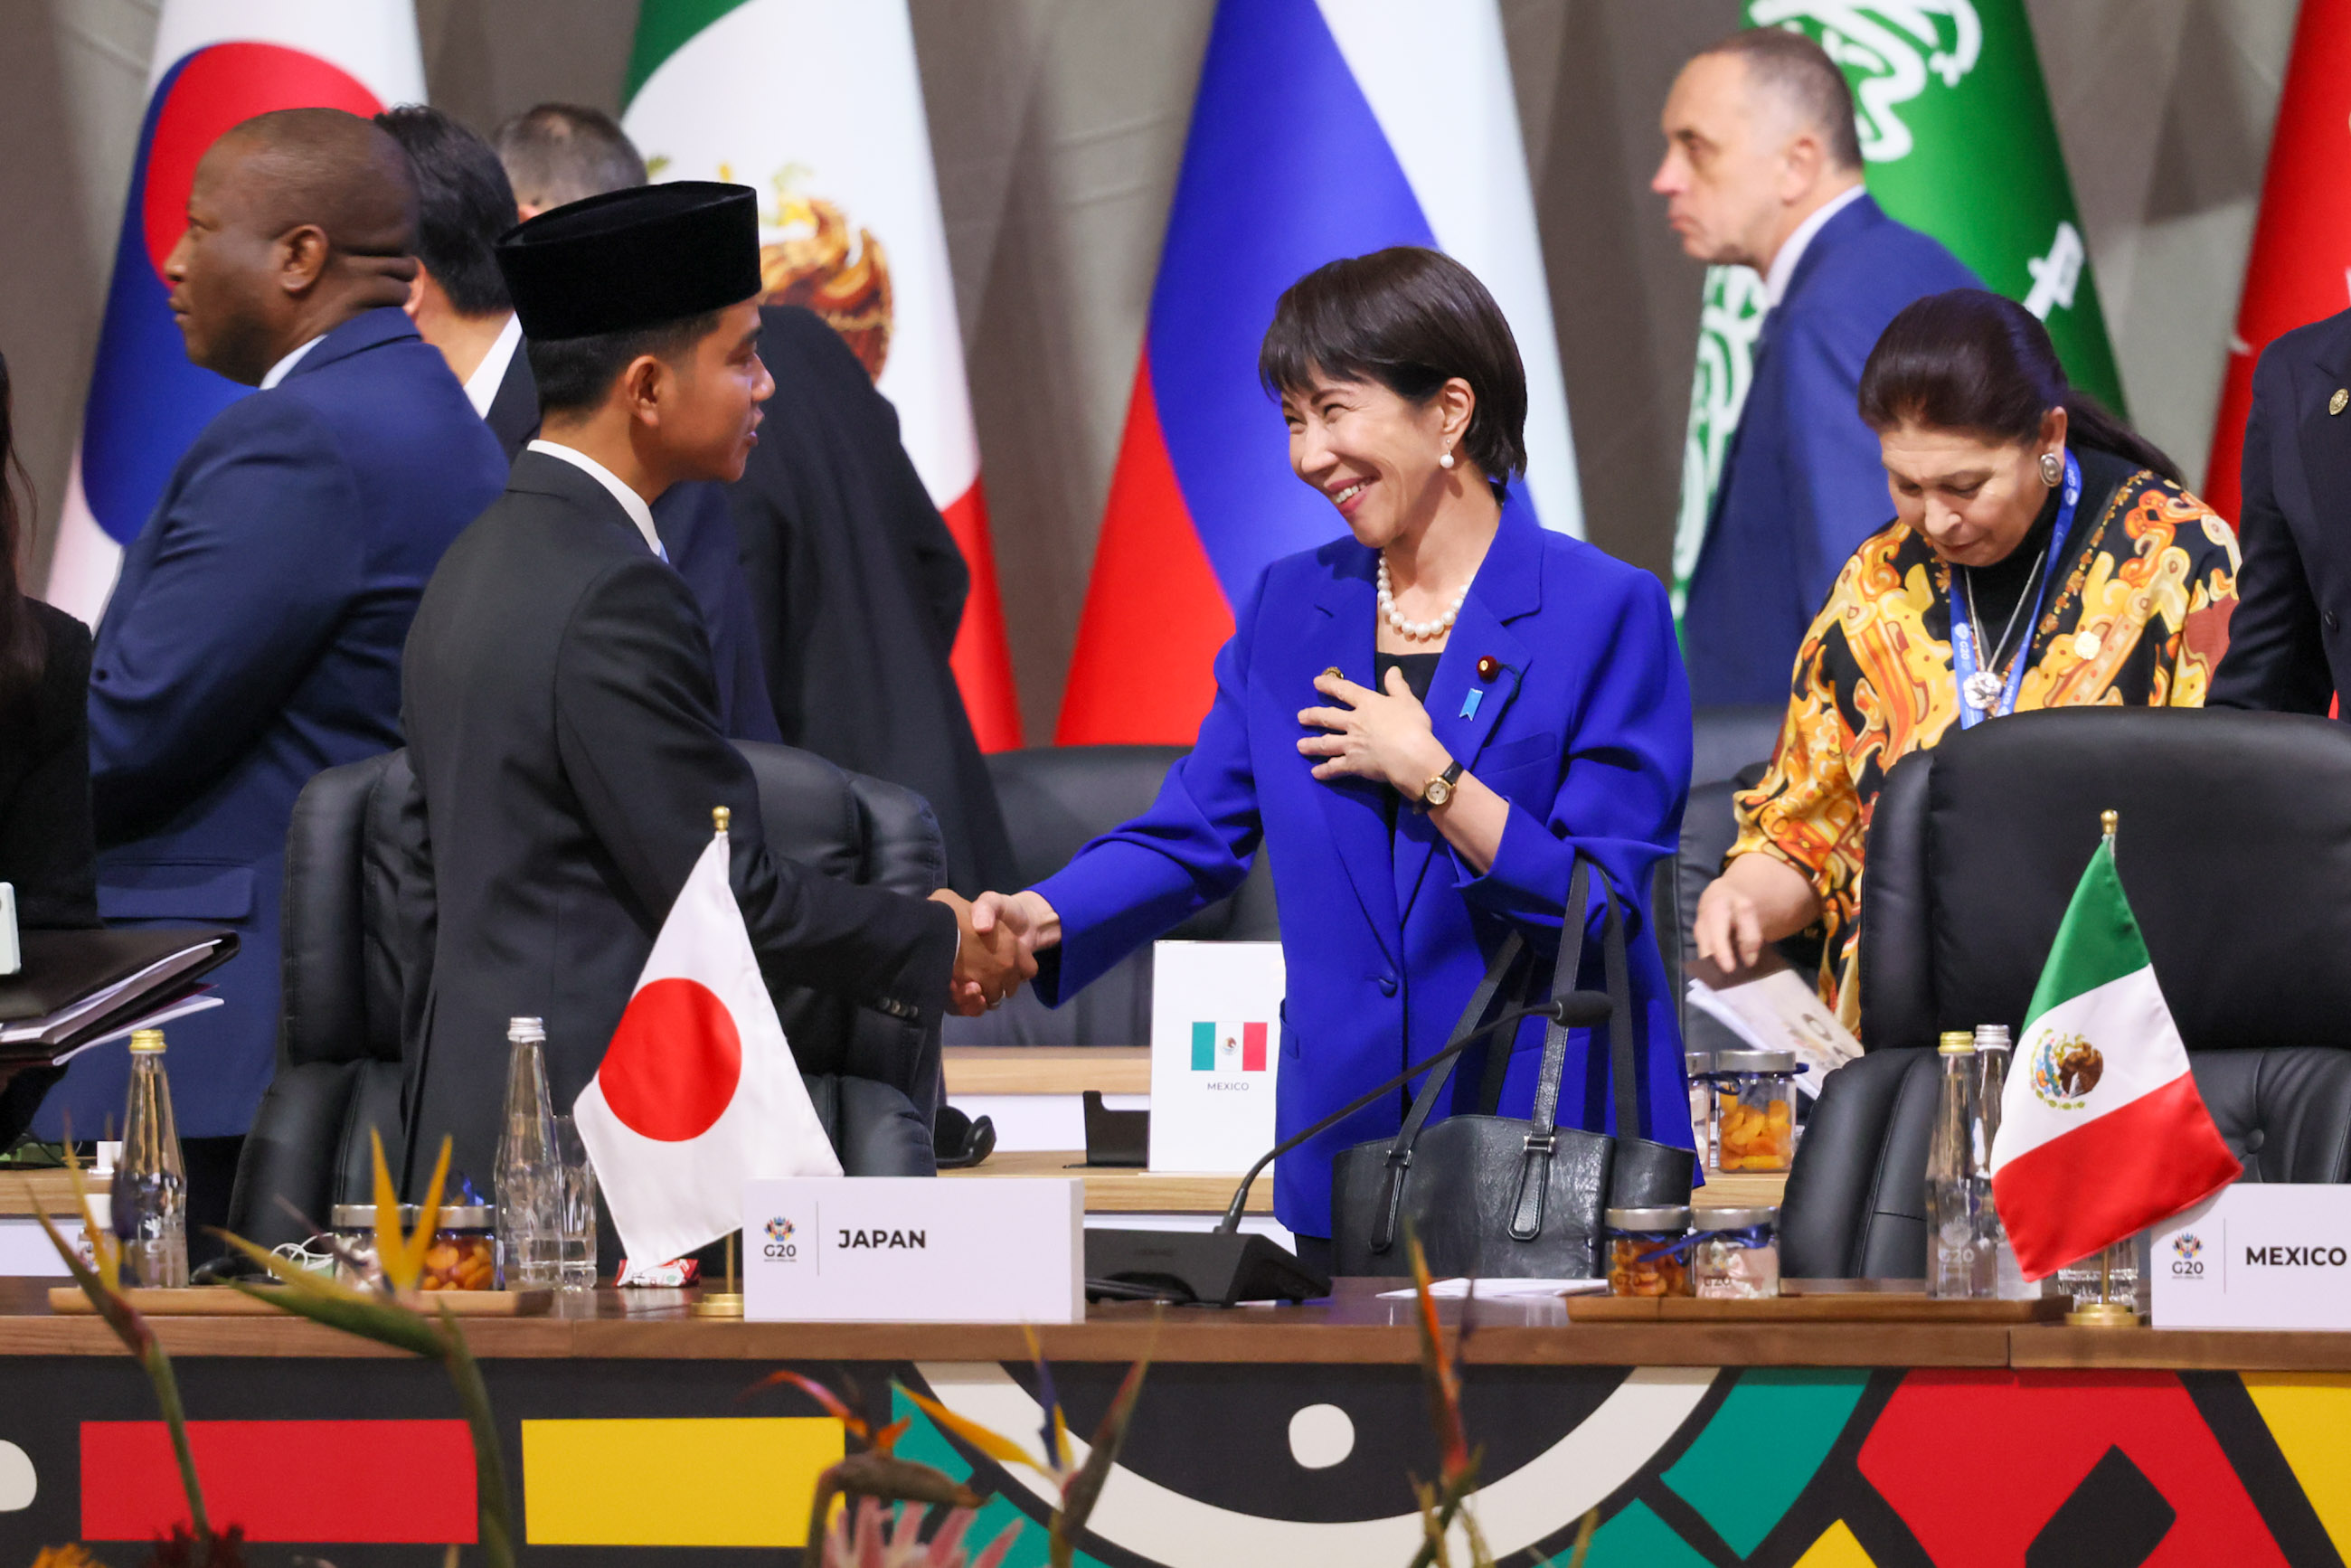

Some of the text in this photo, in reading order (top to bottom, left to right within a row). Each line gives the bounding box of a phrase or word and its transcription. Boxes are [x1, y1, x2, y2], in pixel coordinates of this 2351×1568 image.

[1959, 640, 1970, 660] G20
[1207, 1082, 1250, 1091] MEXICO
[838, 1230, 926, 1249] JAPAN
[764, 1244, 797, 1258] G20
[2246, 1247, 2347, 1266] MEXICO
[2172, 1261, 2205, 1274] G20
